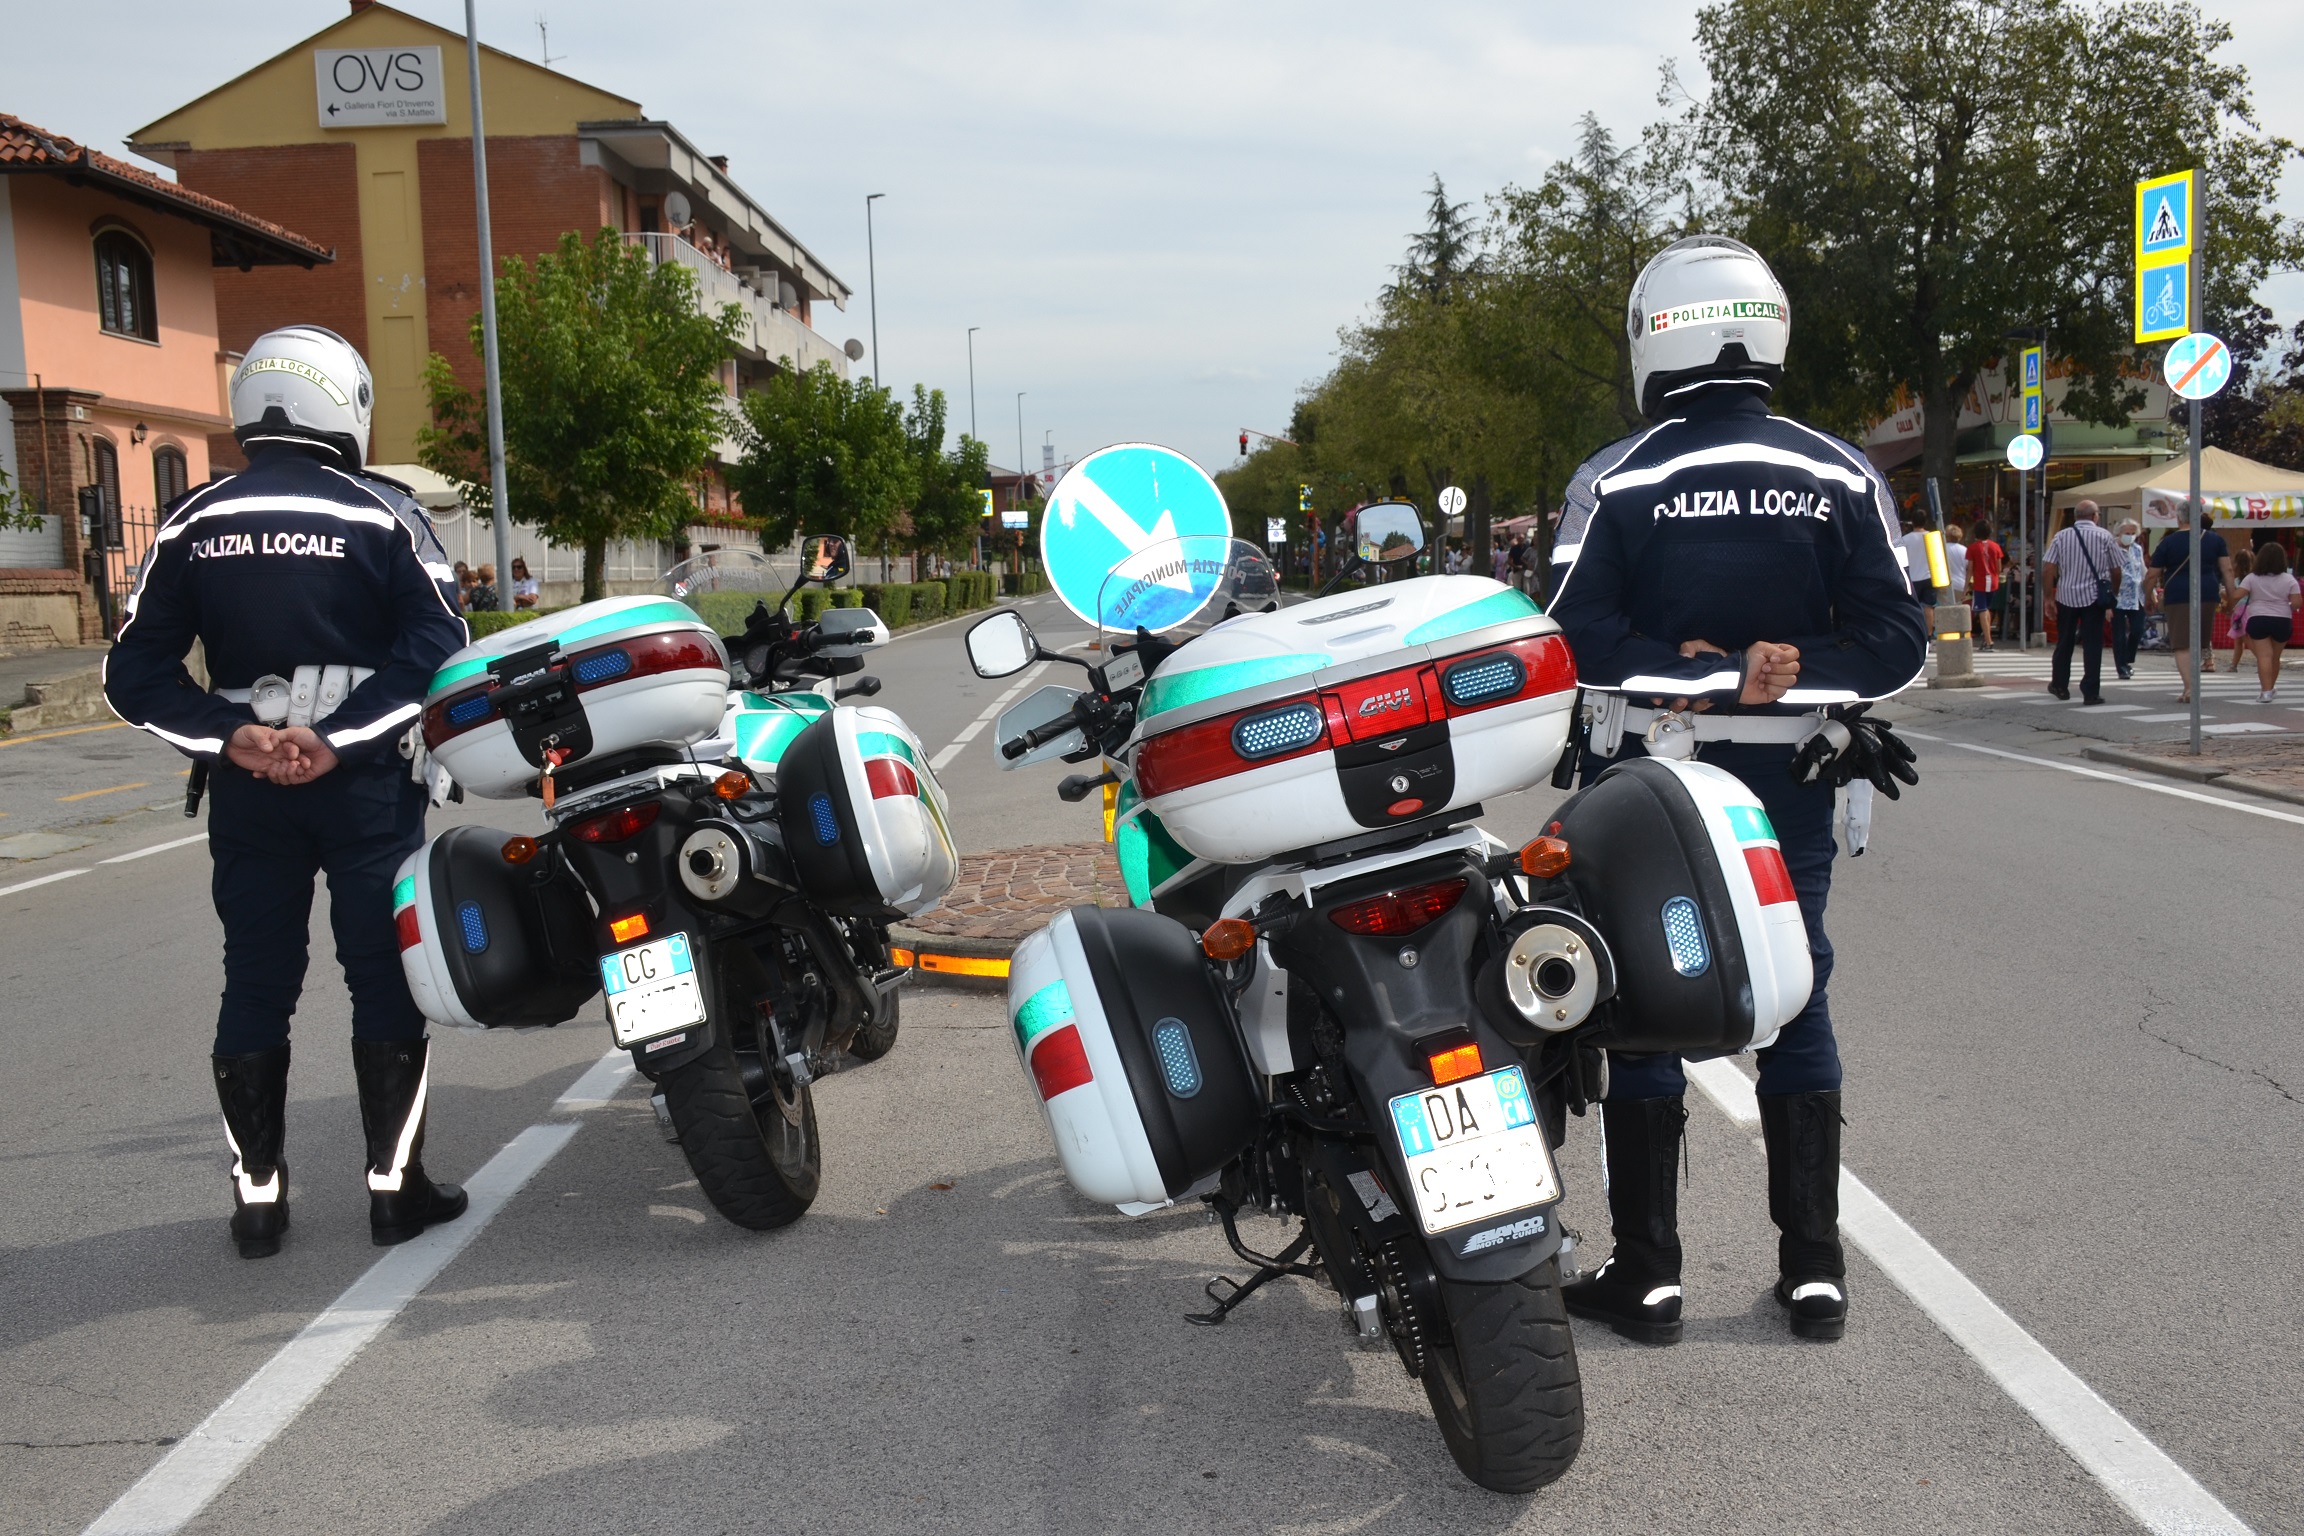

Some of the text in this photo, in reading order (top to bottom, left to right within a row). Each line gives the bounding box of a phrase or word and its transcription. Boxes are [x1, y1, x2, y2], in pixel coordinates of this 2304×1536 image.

[333, 53, 424, 93] OVS
[344, 99, 435, 110] Galleria Fiori D'Inverno
[399, 108, 436, 117] S.Matteo
[1672, 303, 1780, 324] POLIZIA LOCALE
[240, 359, 327, 386] POLIZIA LOCALE
[1653, 488, 1832, 526] POLIZIA LOCALE
[188, 532, 346, 561] POLIZIA LOCALE
[1358, 687, 1413, 718] GIVI
[623, 948, 656, 984] CG
[1501, 1079, 1516, 1094] 07
[1425, 1086, 1480, 1142] DA
[1503, 1097, 1531, 1125] CN
[1468, 1215, 1544, 1246] BIANCO
[1476, 1237, 1504, 1251] MOTO
[1512, 1225, 1545, 1240] CUNEO
